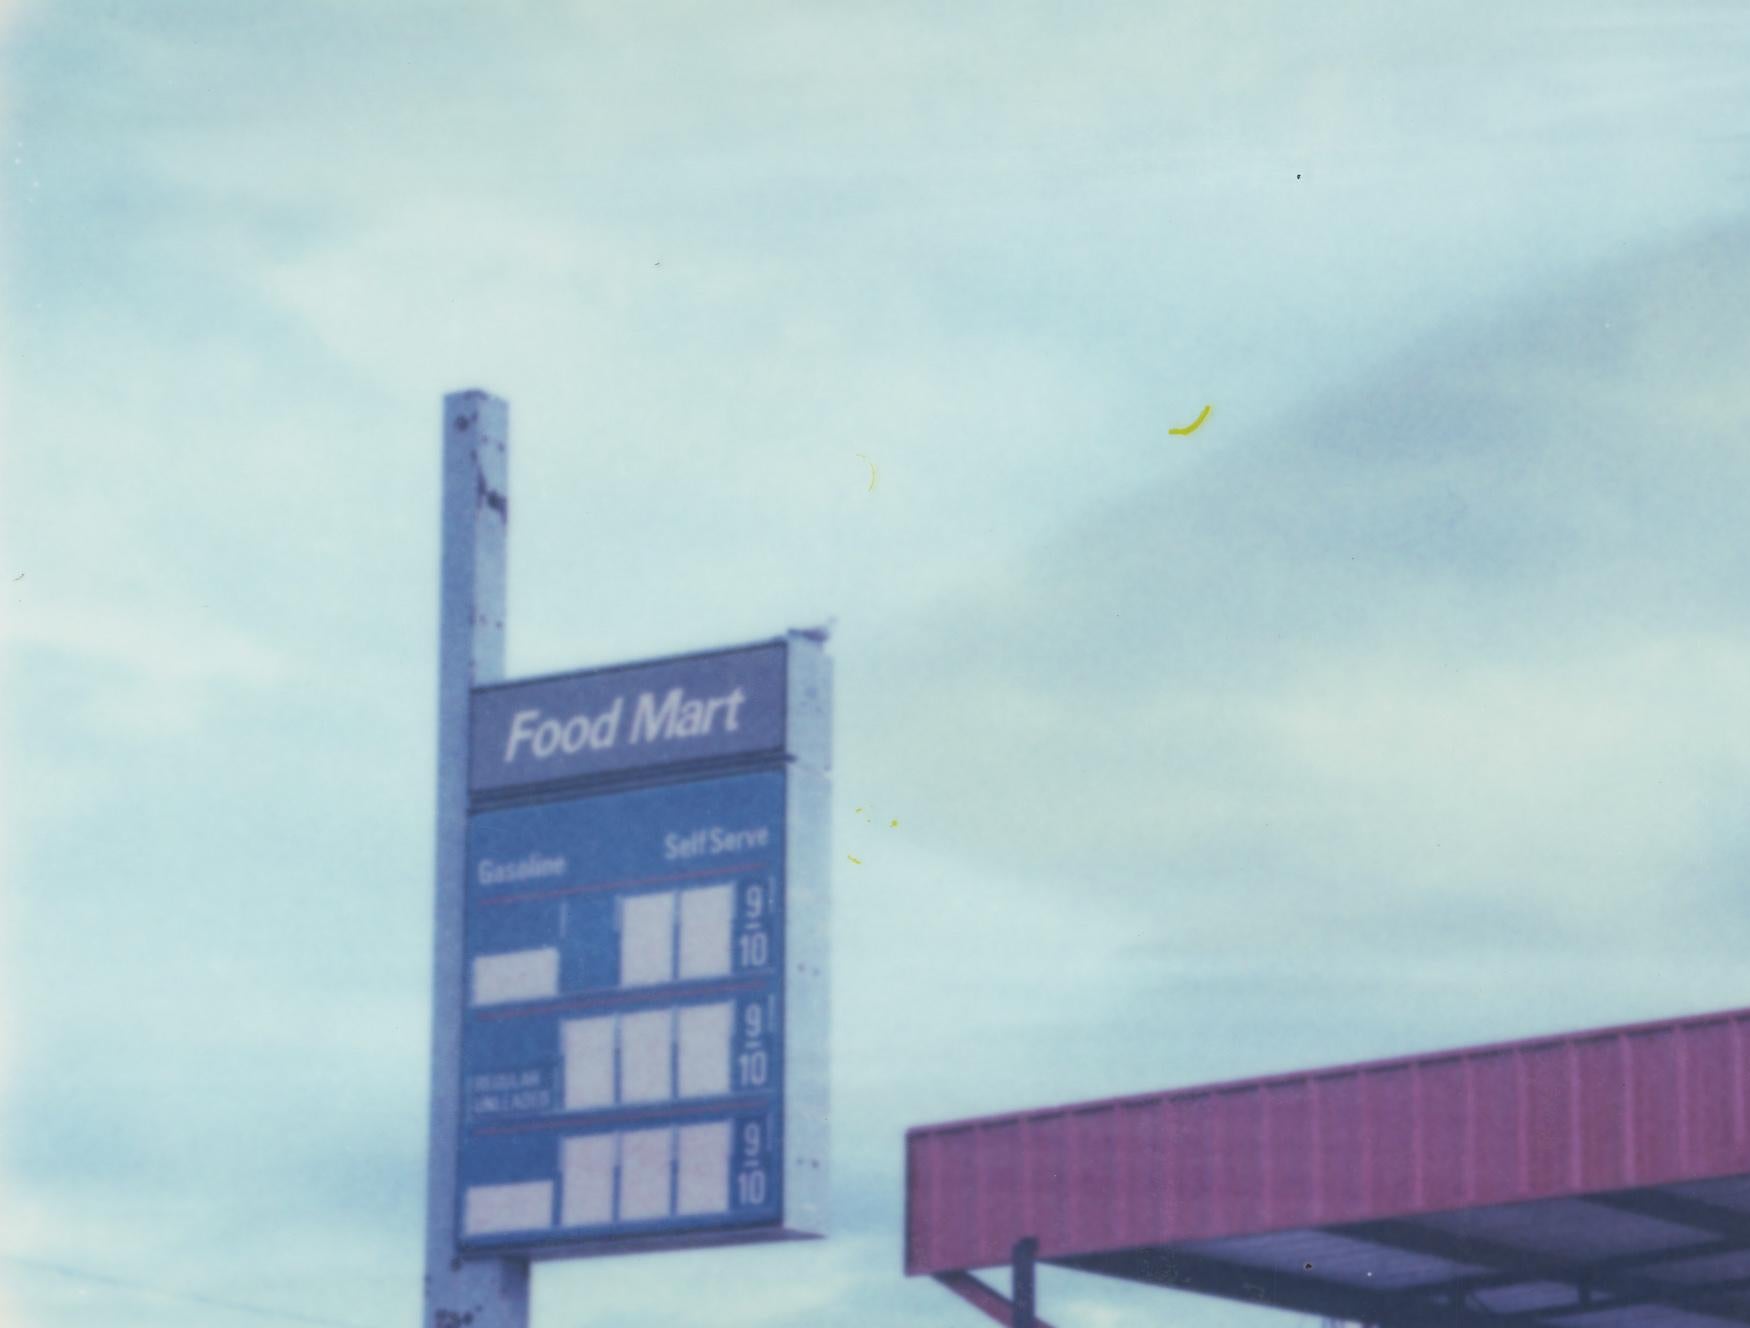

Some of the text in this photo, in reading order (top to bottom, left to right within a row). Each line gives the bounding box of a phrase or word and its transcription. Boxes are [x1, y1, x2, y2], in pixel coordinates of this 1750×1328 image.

[503, 687, 746, 762] Food Mart
[664, 825, 768, 860] Self Serve
[478, 854, 566, 885] Gasoline
[745, 885, 762, 918] 9
[740, 932, 768, 967] 10
[745, 1003, 762, 1038] 9
[738, 1051, 767, 1087] 10
[744, 1122, 761, 1157] 9
[738, 1170, 766, 1205] 10
